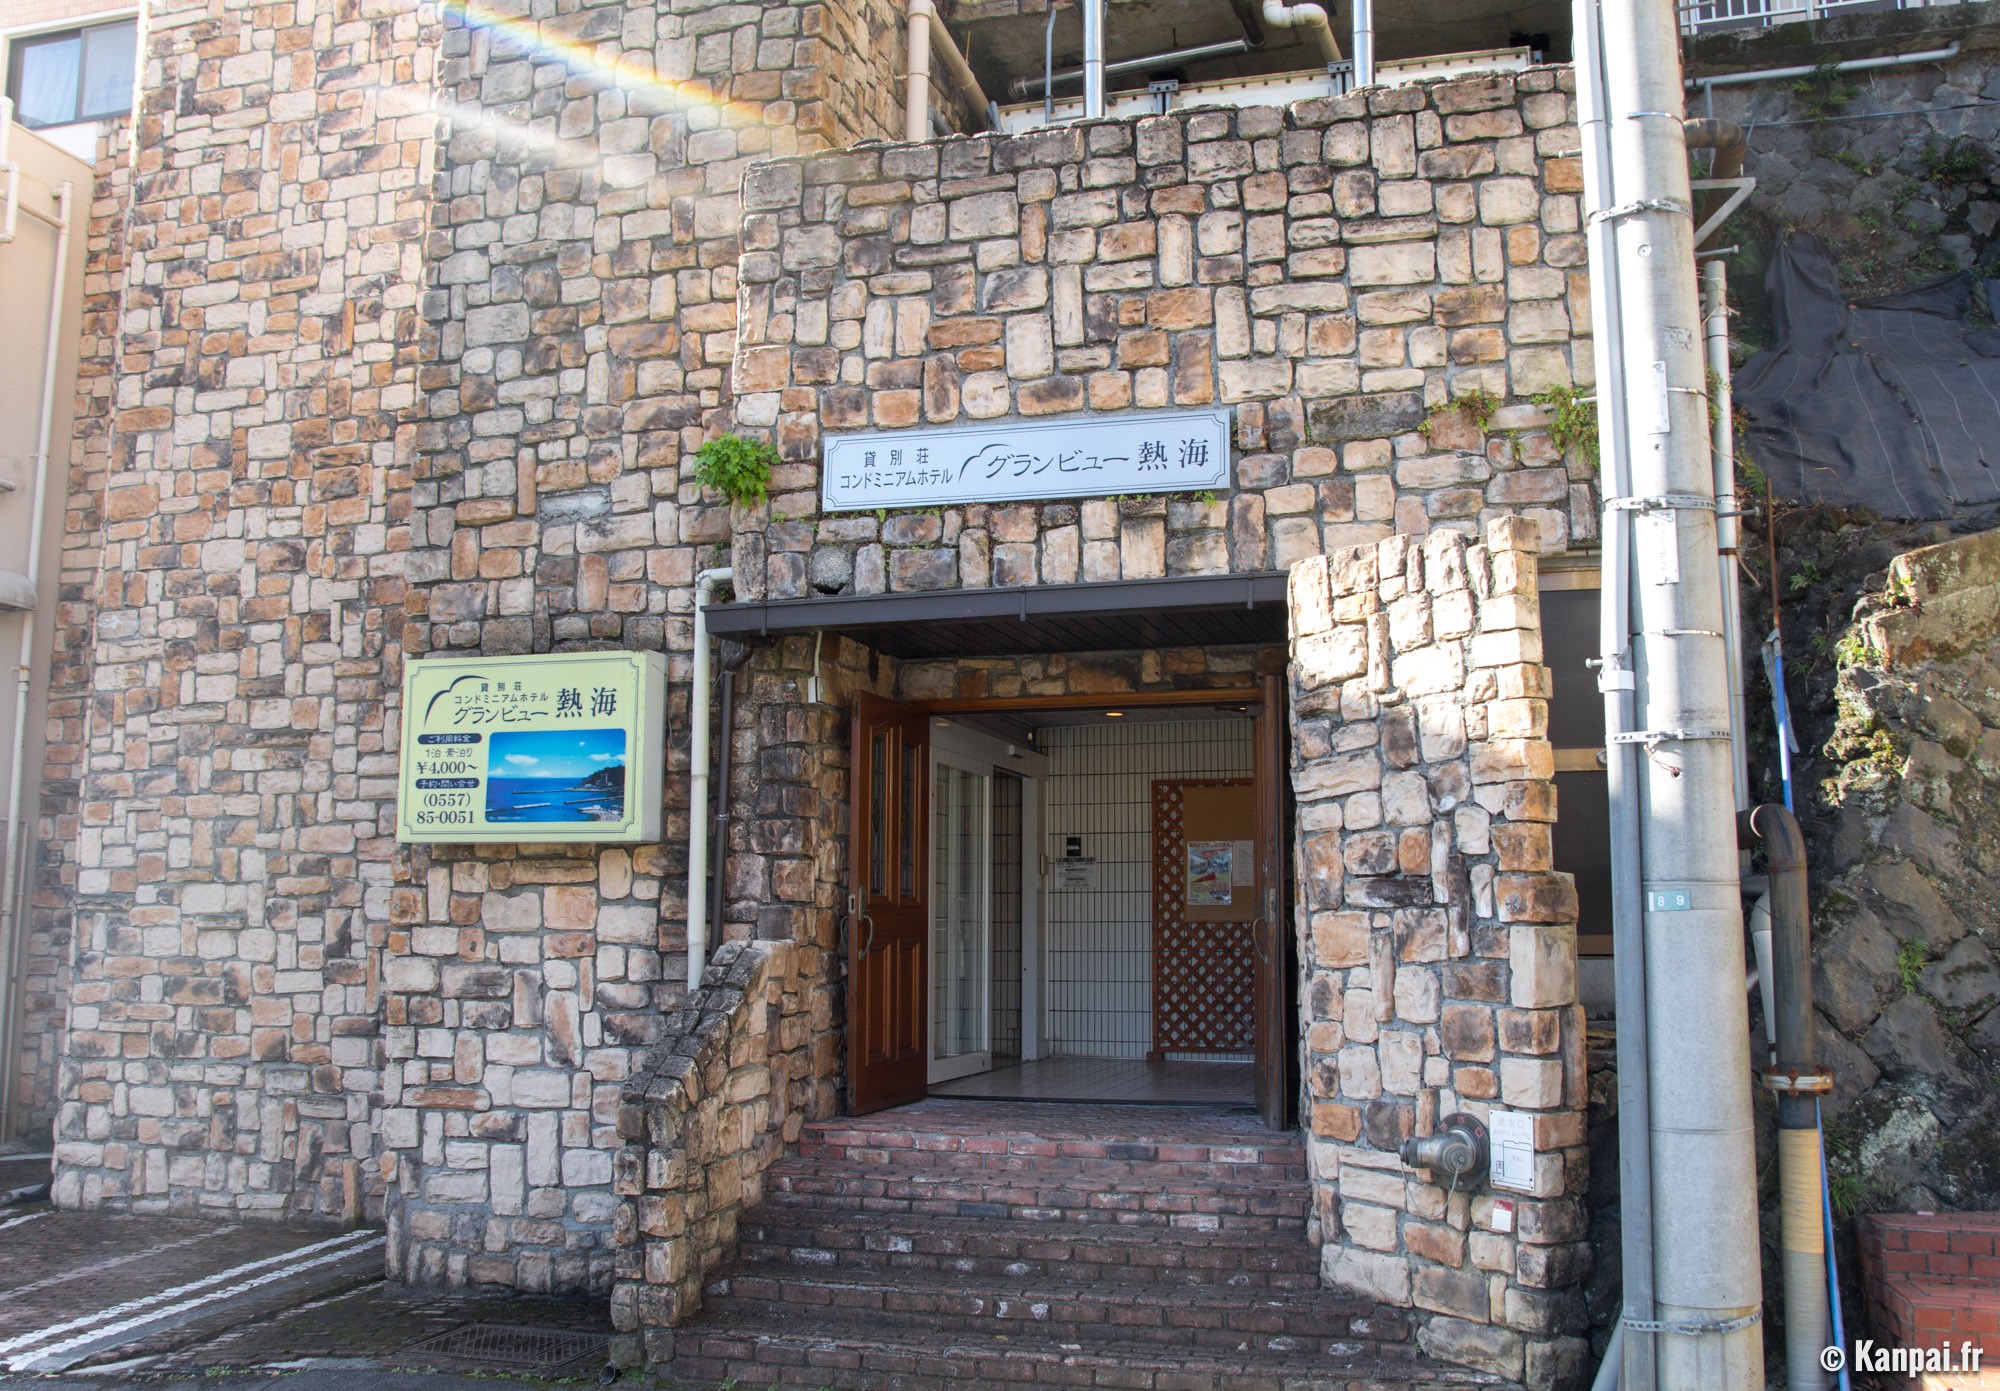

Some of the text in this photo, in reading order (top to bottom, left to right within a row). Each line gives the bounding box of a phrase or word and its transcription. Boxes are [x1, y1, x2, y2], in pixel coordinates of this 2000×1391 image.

[863, 447, 930, 468] 貸別荘
[840, 466, 954, 490] コンドミニアムホテル
[480, 681, 523, 693] 貸別荘
[454, 692, 549, 704] コンドミニアムホテル
[555, 687, 618, 719] 熱海
[453, 705, 549, 725] グランビュー
[428, 734, 472, 744] ご利用料金
[423, 792, 471, 808] (0557)
[416, 810, 475, 824] 85-0051
